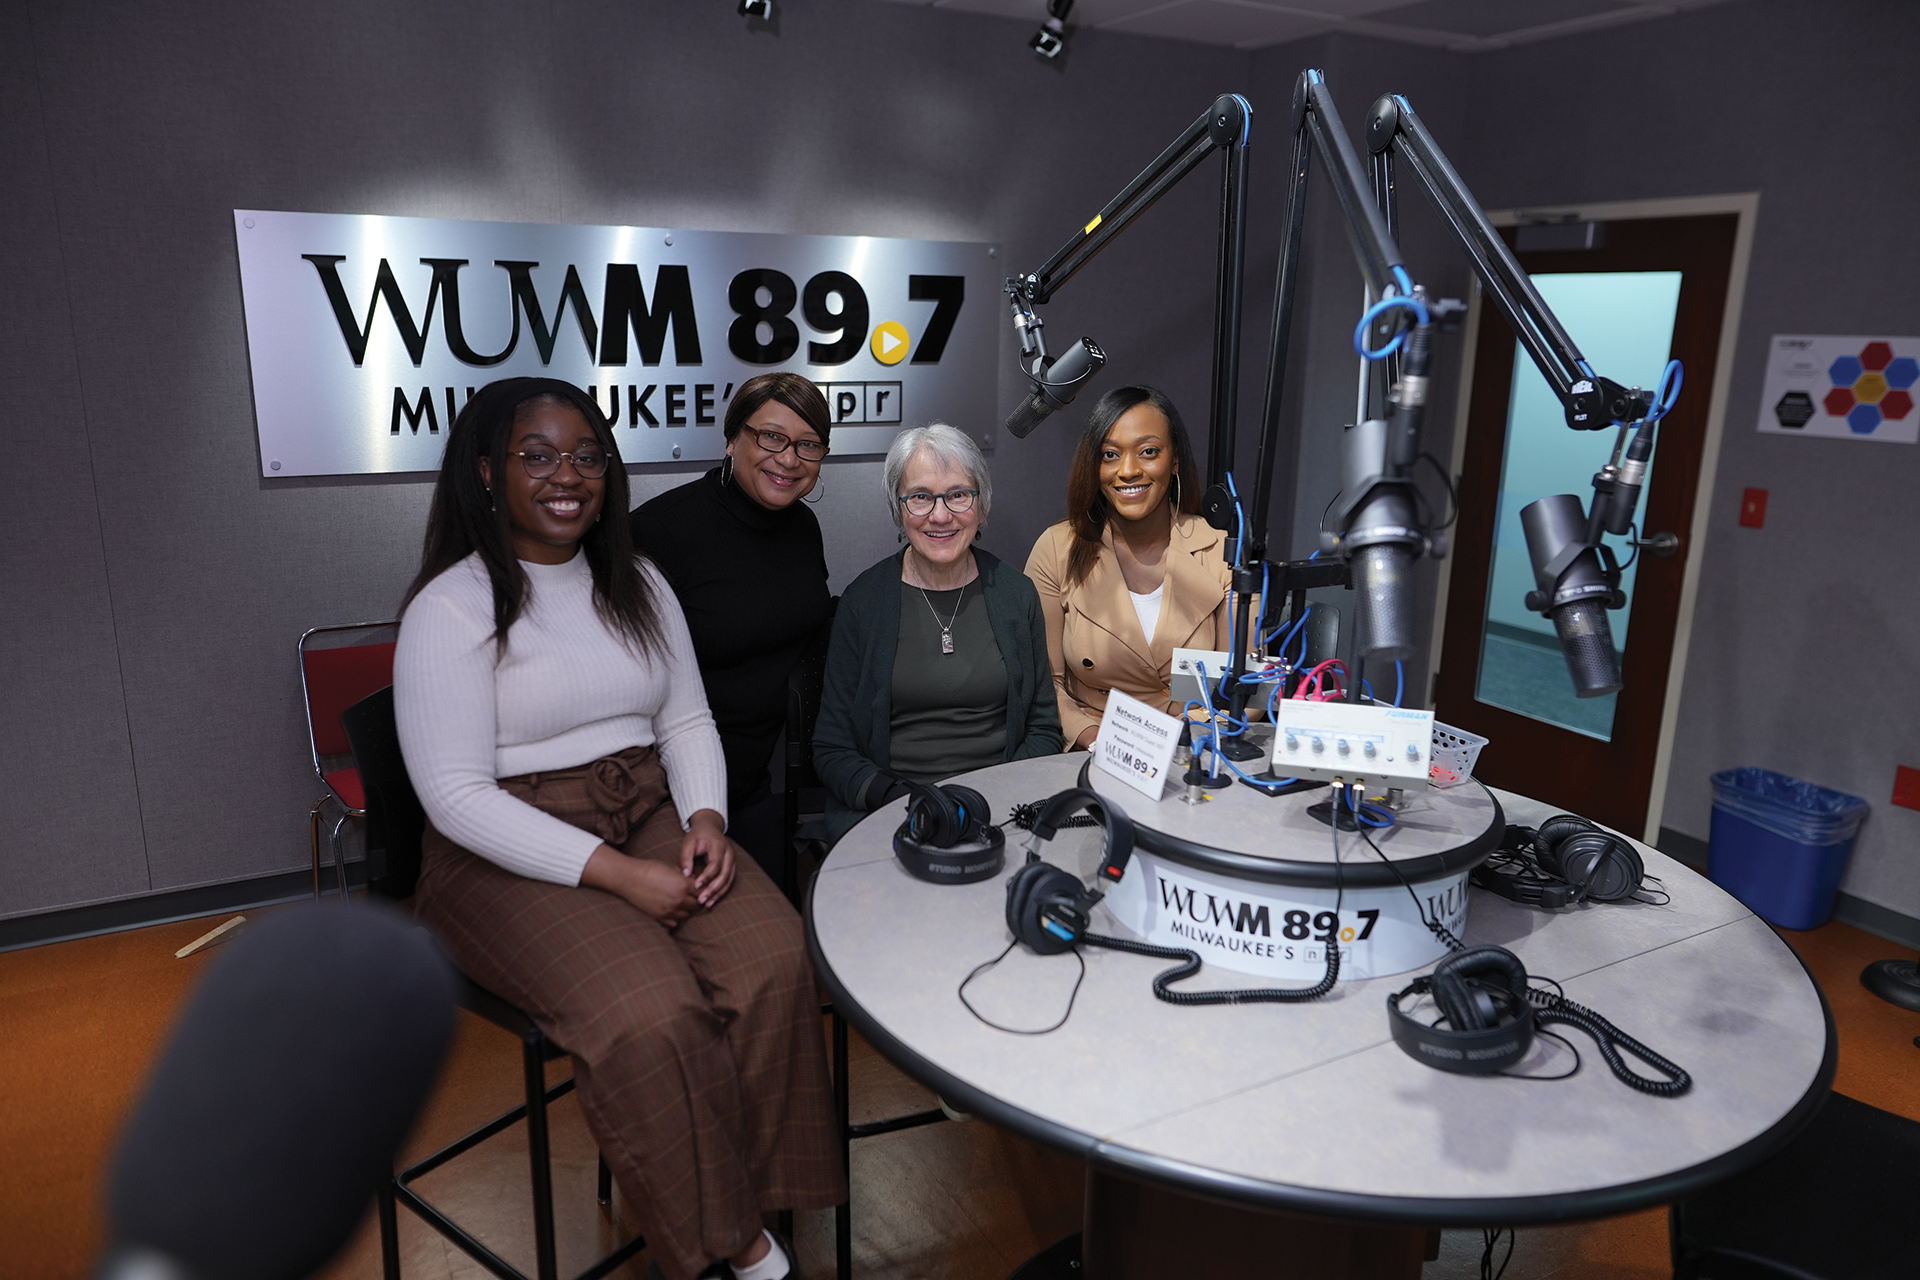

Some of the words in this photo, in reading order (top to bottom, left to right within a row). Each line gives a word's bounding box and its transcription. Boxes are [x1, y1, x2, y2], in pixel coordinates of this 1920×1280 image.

[301, 254, 702, 367] WUWM
[727, 268, 966, 366] 89.7
[1115, 705, 1142, 724] Network
[1144, 720, 1169, 737] Access
[1385, 710, 1428, 719] FURMAN
[1105, 741, 1133, 766] WUWM
[928, 863, 962, 875] STUDIO
[1158, 876, 1271, 937] WUWM
[1282, 909, 1380, 942] 89.7
[1170, 919, 1295, 960] MILWAUKEE'S
[1306, 948, 1348, 961] nr
[1418, 1041, 1463, 1060] STUDIO
